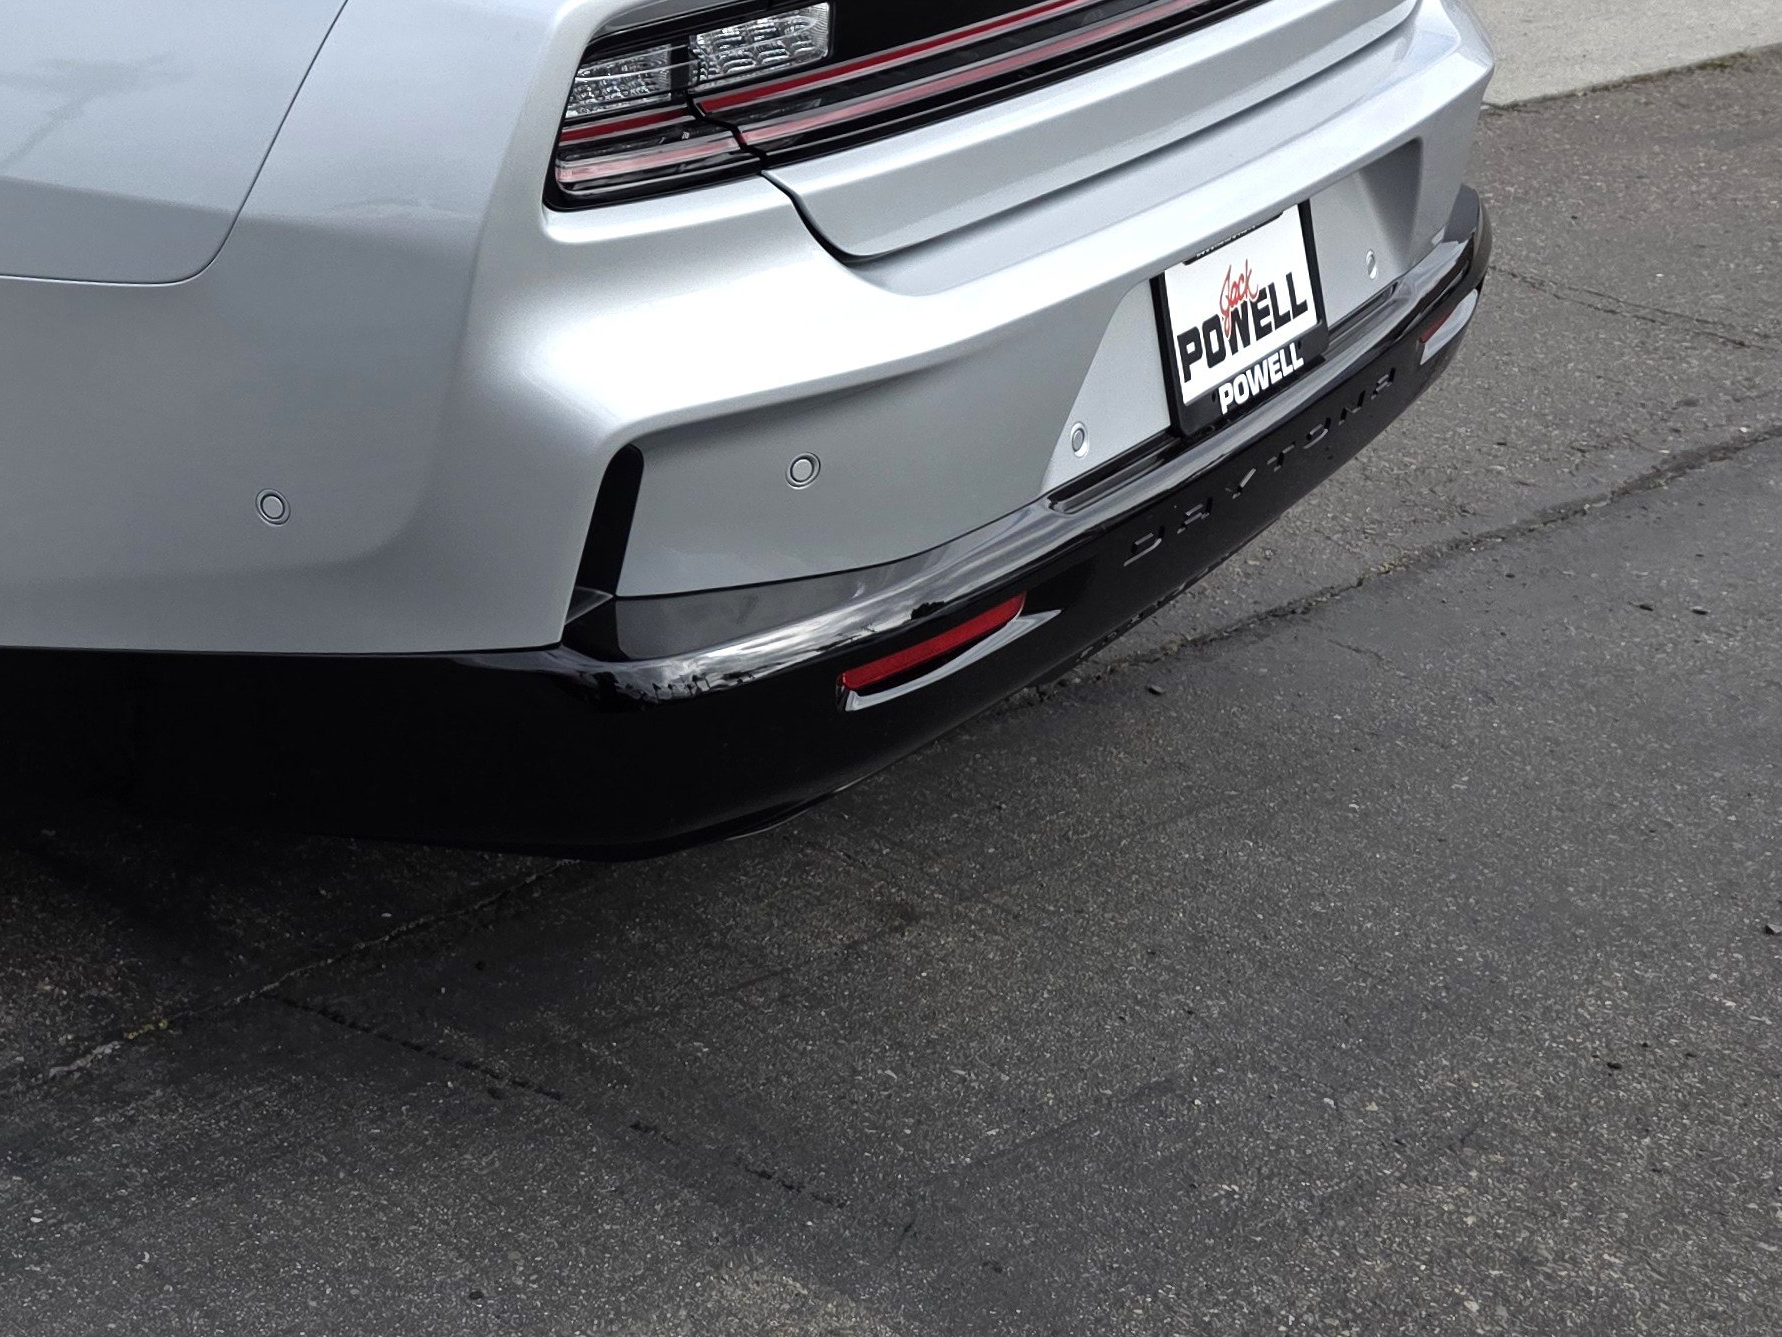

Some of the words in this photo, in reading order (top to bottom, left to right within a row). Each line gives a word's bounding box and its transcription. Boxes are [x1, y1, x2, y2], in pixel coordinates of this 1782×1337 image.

[1176, 272, 1309, 383] POWELL
[1220, 258, 1259, 339] Jack
[1218, 342, 1305, 415] POWELL
[1123, 366, 1396, 567] DAYTONA
